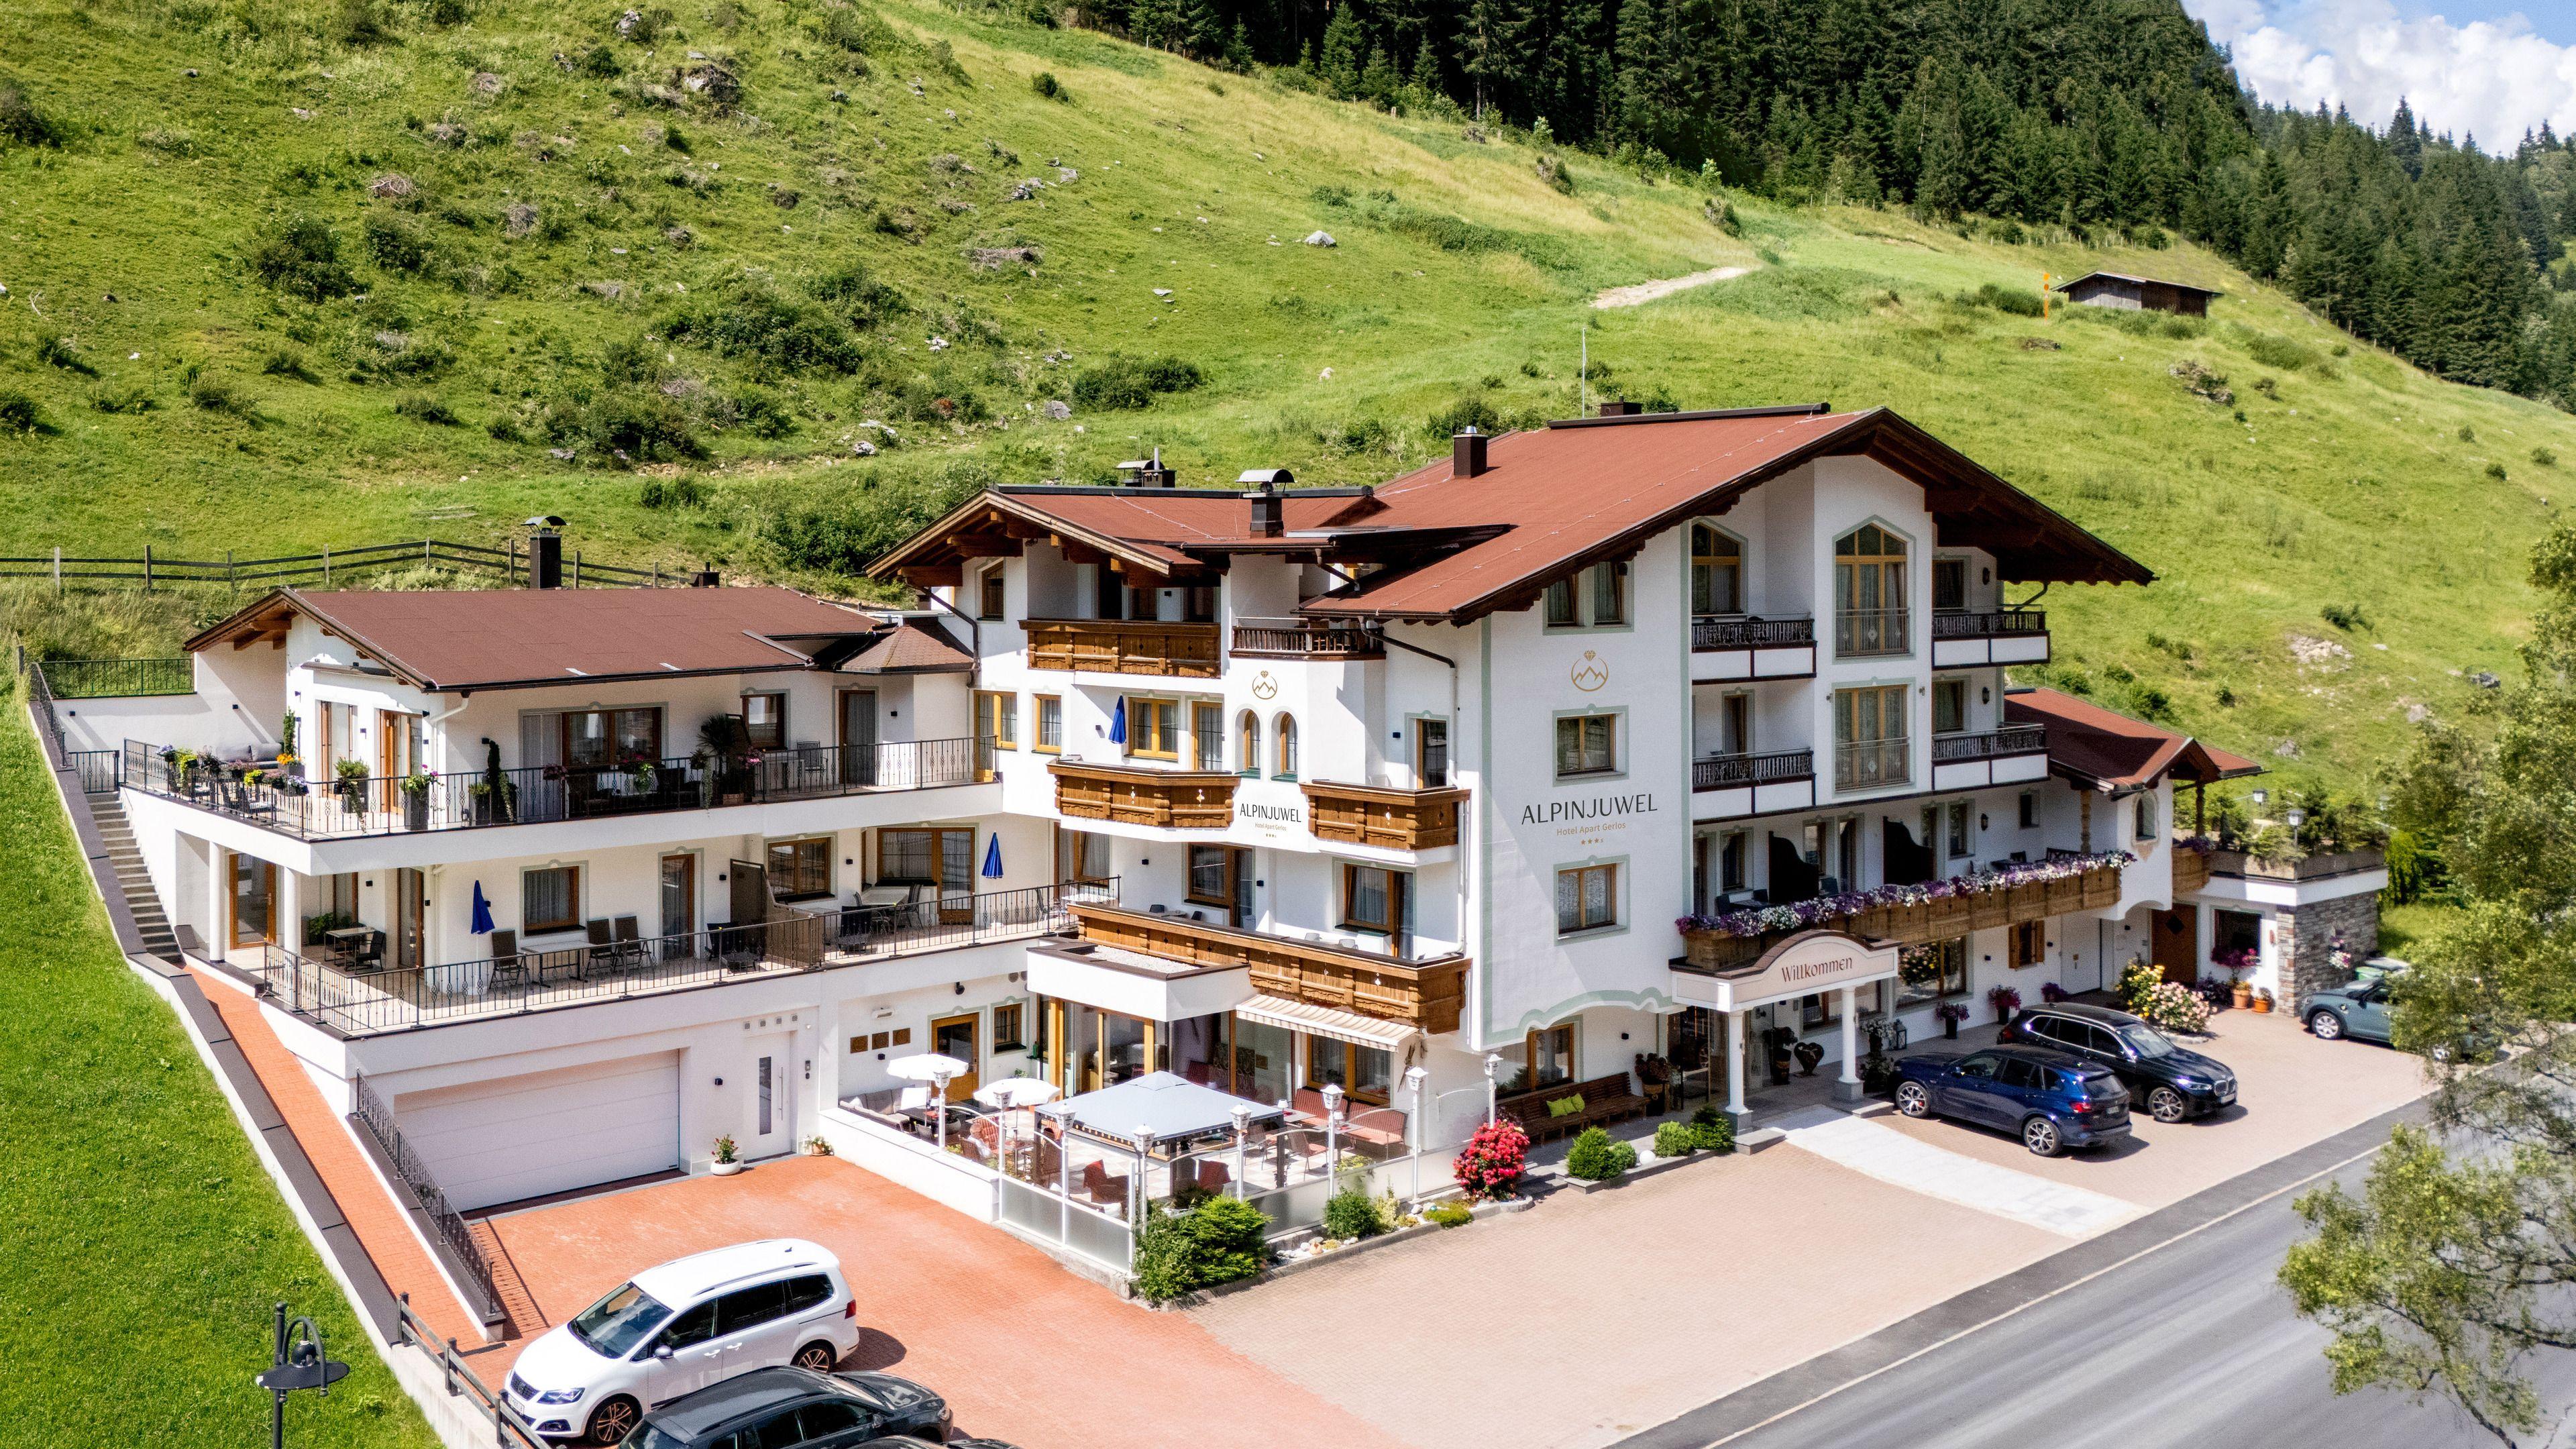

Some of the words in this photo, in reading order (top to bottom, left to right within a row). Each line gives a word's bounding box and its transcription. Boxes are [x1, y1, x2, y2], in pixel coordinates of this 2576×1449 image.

[1240, 803, 1301, 822] ALPINJUWEL
[1521, 793, 1658, 825] ALPINJUWEL
[1265, 822, 1275, 830] Apart
[1556, 826, 1578, 836] Hotel
[1579, 824, 1601, 835] Apart
[1602, 822, 1626, 831] Gerlos
[1782, 957, 1852, 983] Willkommen
